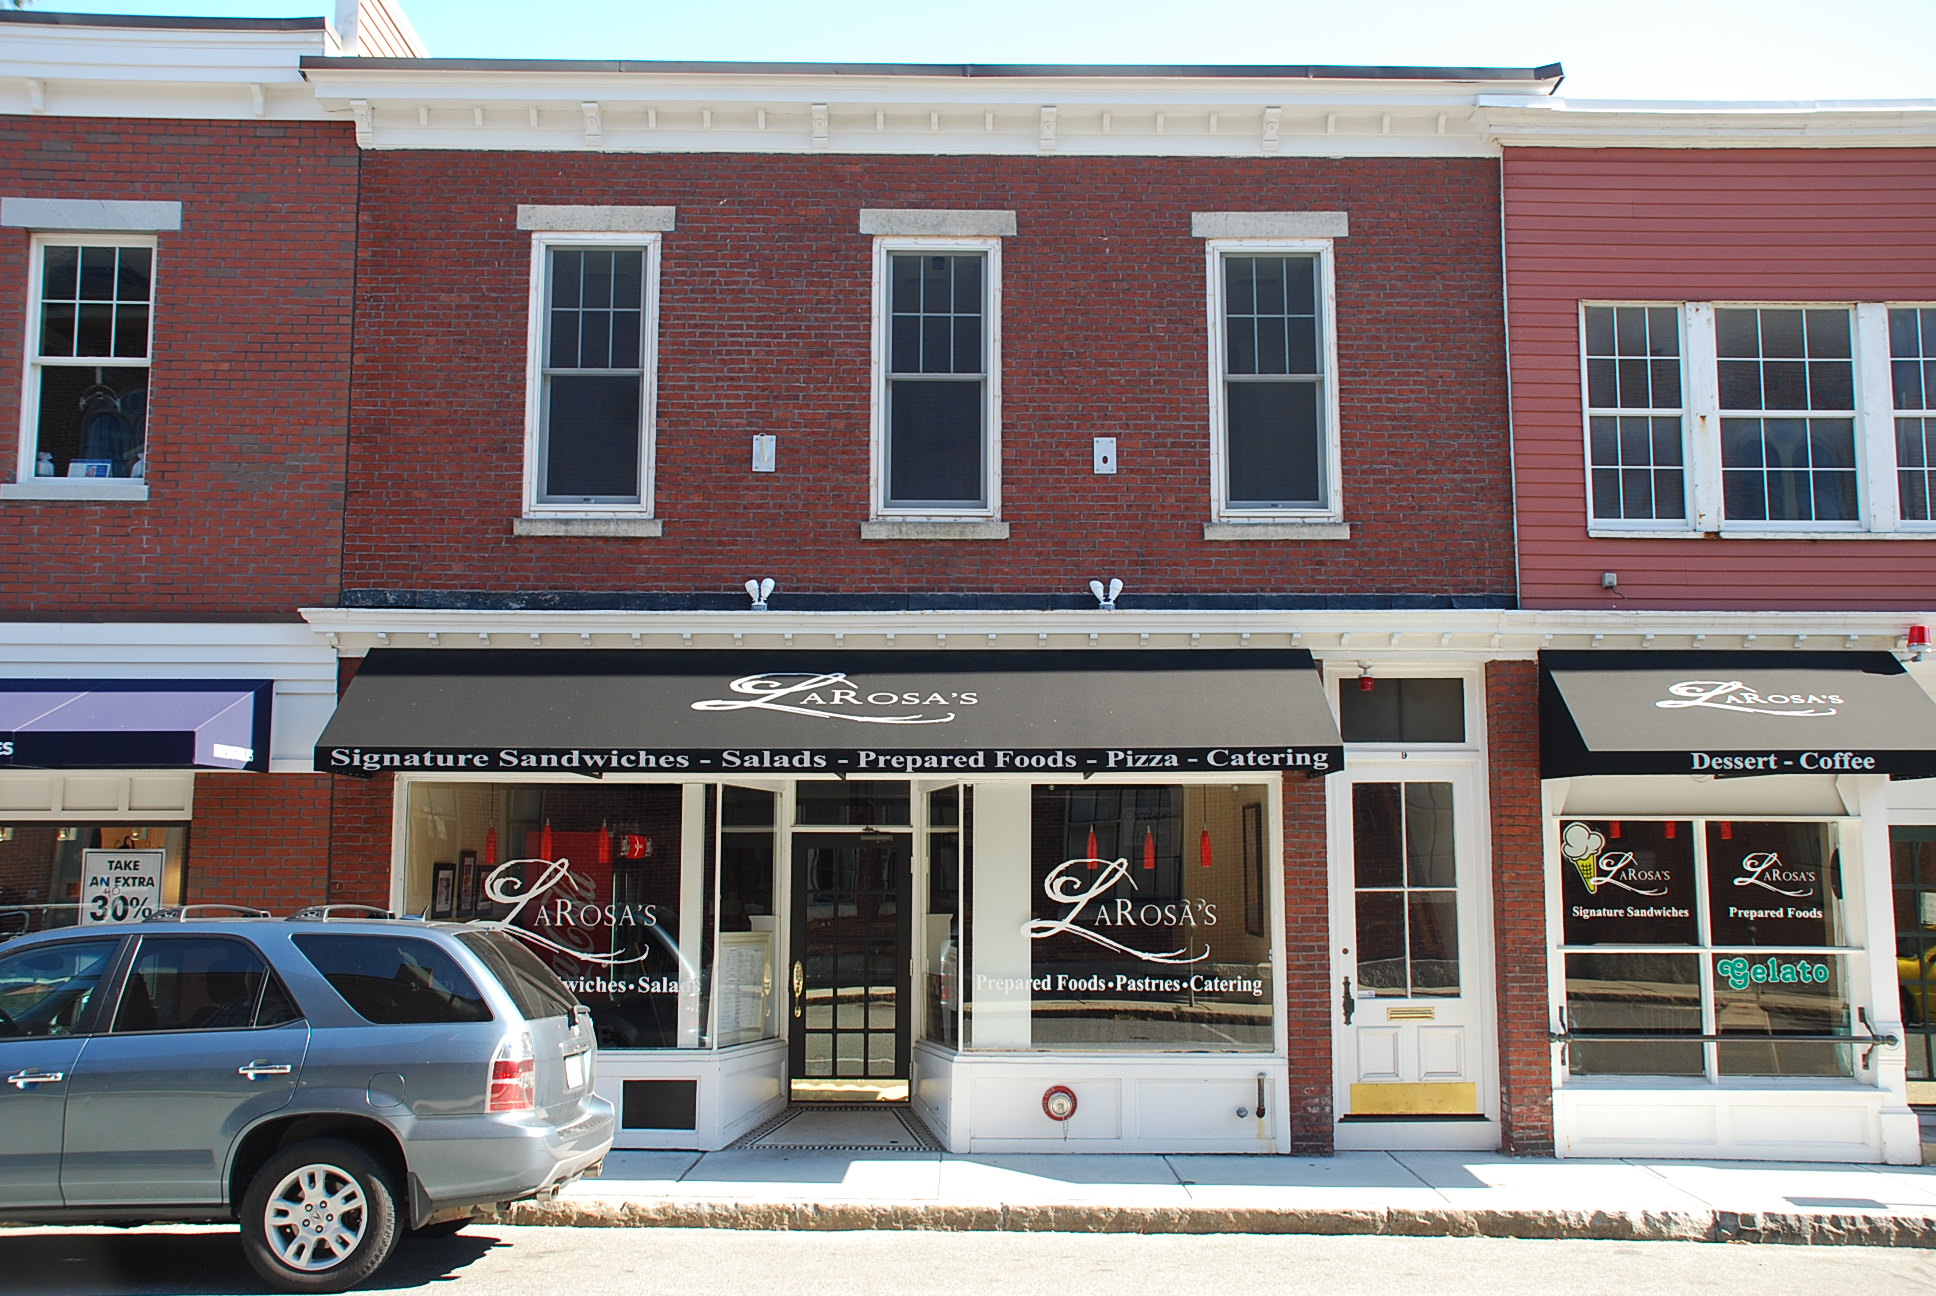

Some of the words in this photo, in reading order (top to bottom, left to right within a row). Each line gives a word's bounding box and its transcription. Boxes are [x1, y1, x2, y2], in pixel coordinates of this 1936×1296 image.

[330, 748, 489, 771] Signature
[499, 749, 690, 768] Sandwiches
[722, 750, 827, 768] Salads
[857, 750, 986, 772] Prepared
[993, 750, 1077, 768] Foods
[1106, 750, 1179, 768] Pizza
[1206, 748, 1329, 770] Catering
[1401, 751, 1408, 760] 9
[1690, 752, 1778, 770] Dessert
[1800, 752, 1876, 770] Coffee
[107, 860, 140, 871] TAKE
[90, 876, 110, 887] AN
[114, 876, 155, 888] EXTRA
[90, 895, 153, 922] 30%
[1572, 906, 1624, 919] Signature
[1627, 906, 1690, 918] Sandwiches
[1728, 907, 1784, 920] Prepared
[1787, 907, 1823, 919] Foods
[1717, 957, 1830, 990] Gelato
[975, 974, 1052, 995] Prepared
[1056, 974, 1106, 992] Foods
[1115, 974, 1181, 992] Pastries
[1190, 974, 1263, 996] Catering
